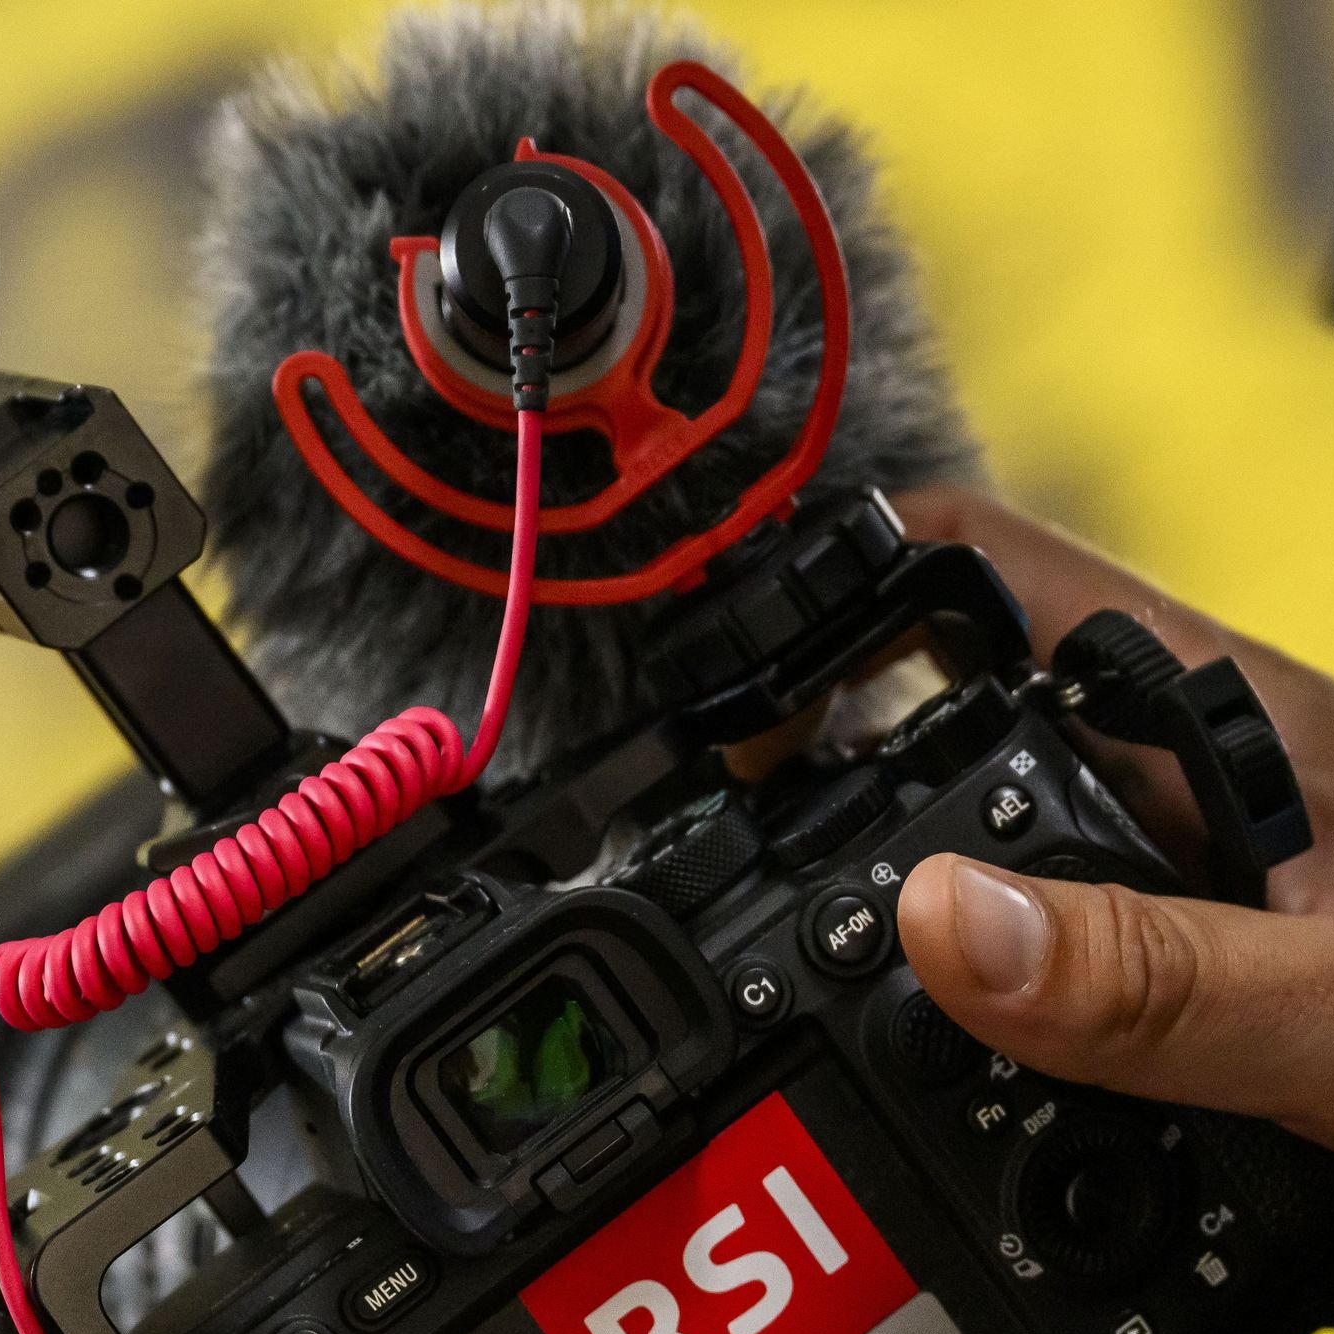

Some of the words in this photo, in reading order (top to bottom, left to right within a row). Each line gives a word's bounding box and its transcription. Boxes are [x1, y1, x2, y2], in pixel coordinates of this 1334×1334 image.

[990, 793, 1030, 828] AEL
[828, 908, 875, 951] AF-ON
[744, 977, 776, 1006] C1
[976, 1104, 1006, 1129] Fn
[1023, 1102, 1055, 1135] DISP
[364, 1263, 417, 1311] MENU
